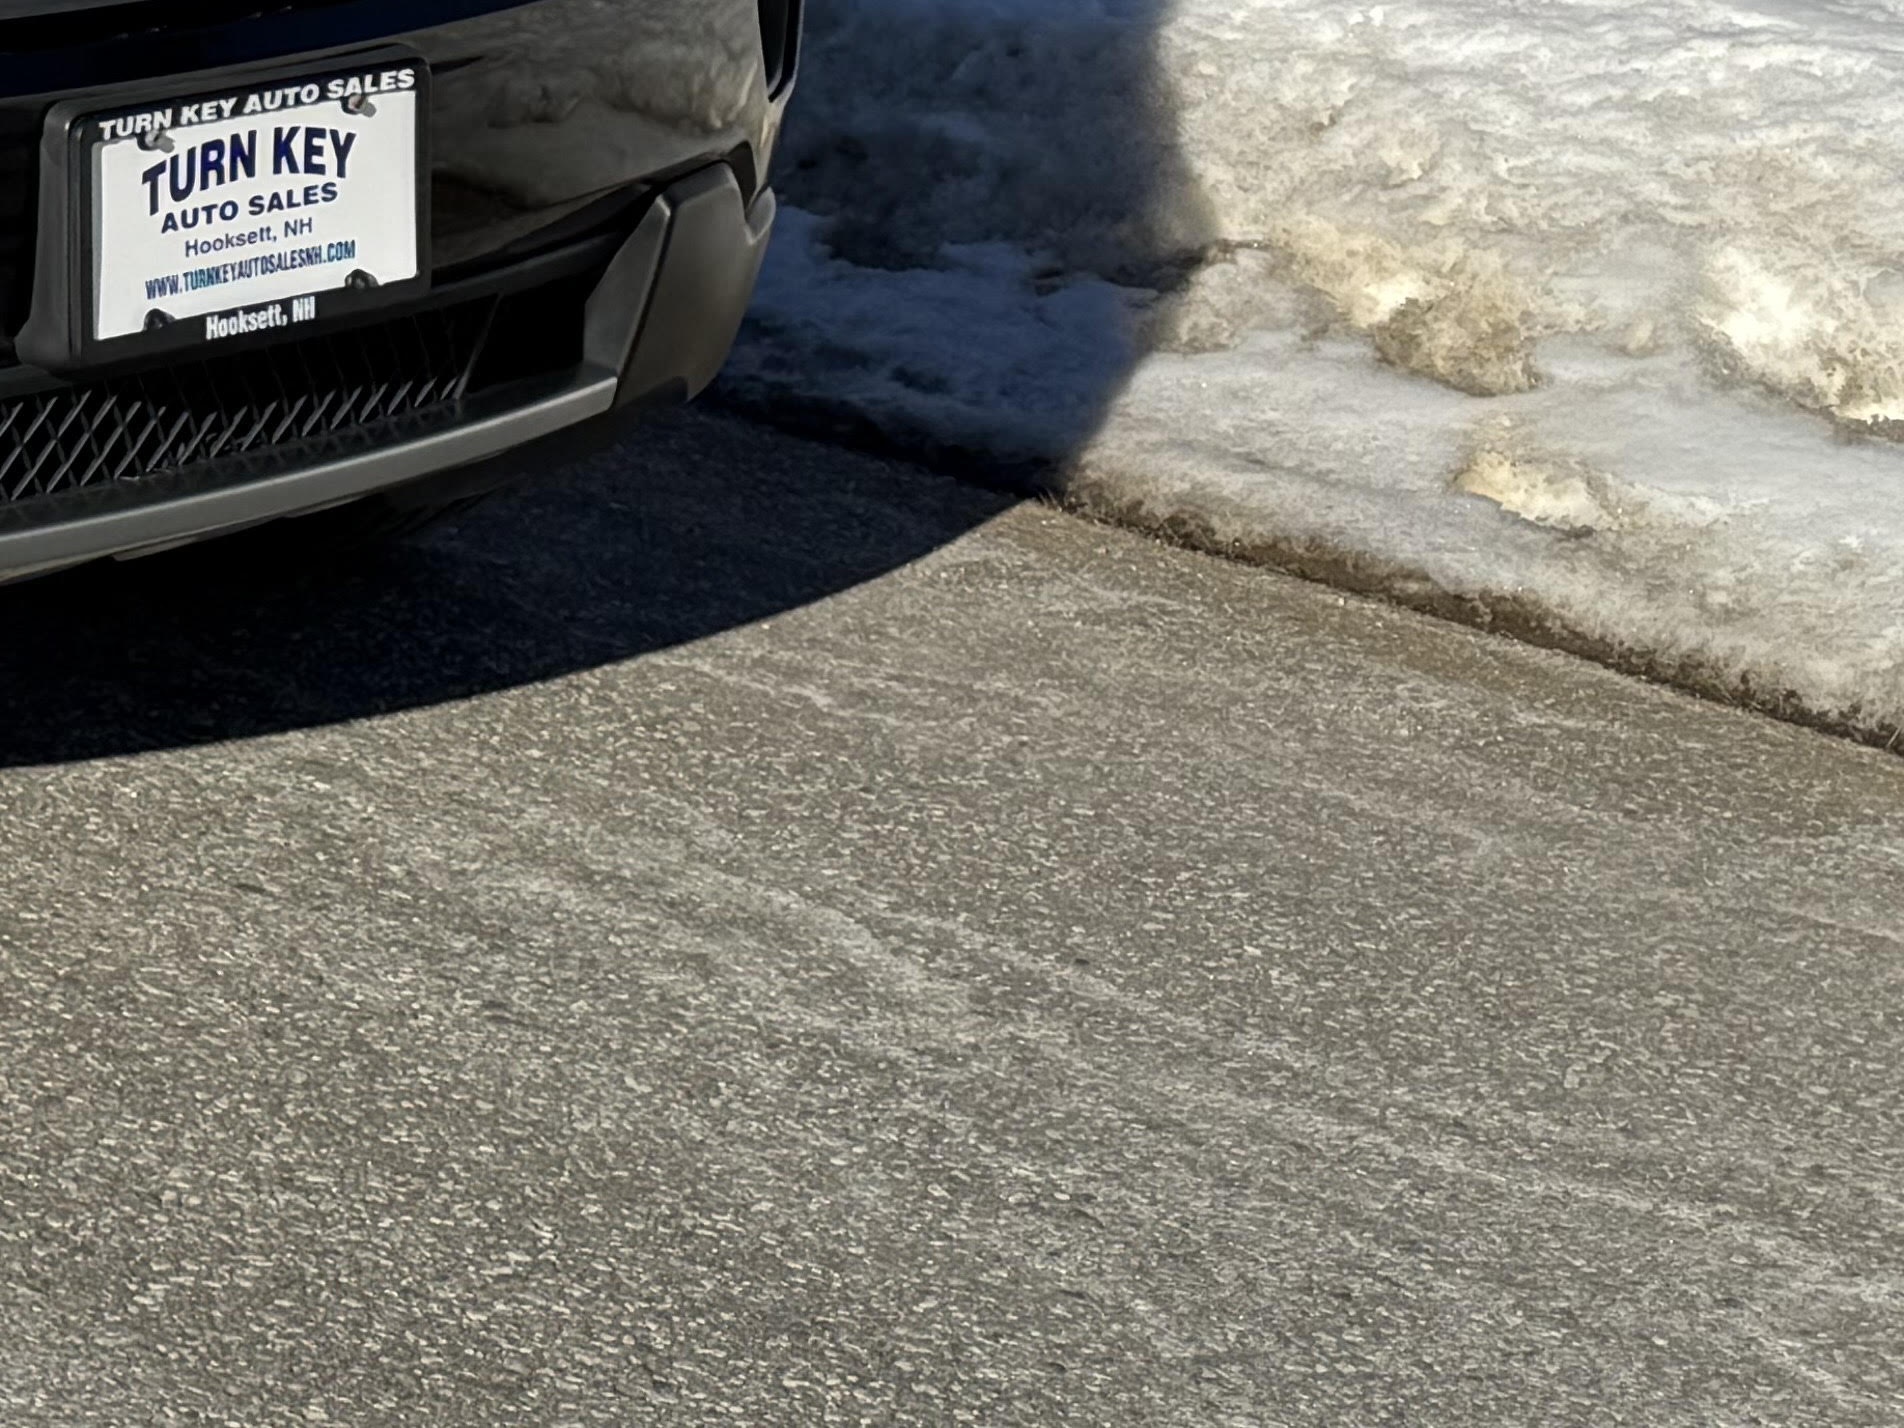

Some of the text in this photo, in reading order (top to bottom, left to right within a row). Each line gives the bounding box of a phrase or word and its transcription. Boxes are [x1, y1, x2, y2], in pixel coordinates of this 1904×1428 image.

[99, 69, 415, 140] TURN KEY AUTO SALES
[142, 126, 356, 216] TURN KEY
[161, 182, 338, 234] AUTO SALES
[185, 218, 313, 257] Hooksett, NH
[145, 240, 356, 299] WWW.TURNKEYAUTOSALESNH.COM
[206, 296, 315, 339] Hooksett, NH
